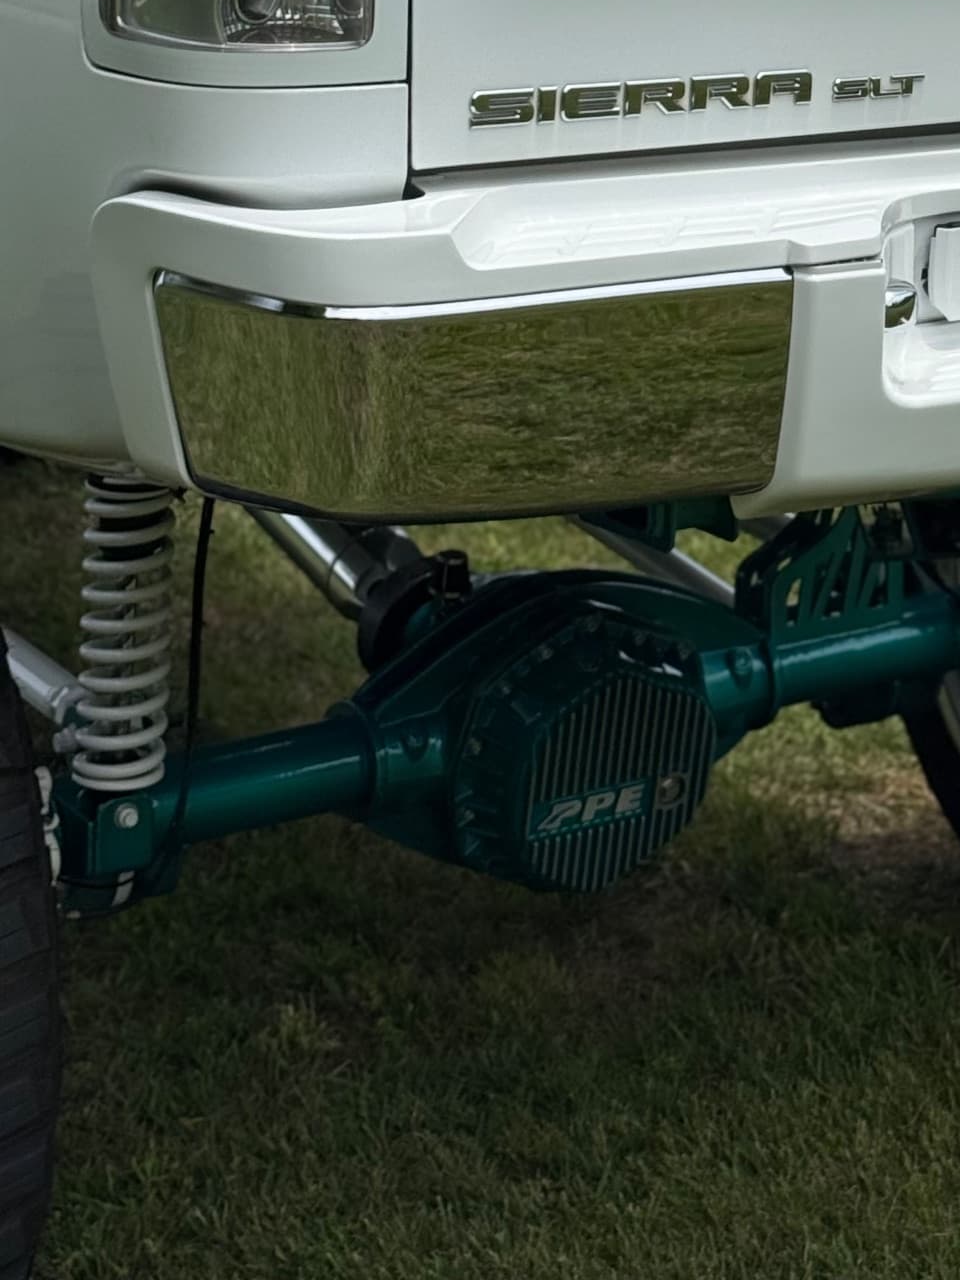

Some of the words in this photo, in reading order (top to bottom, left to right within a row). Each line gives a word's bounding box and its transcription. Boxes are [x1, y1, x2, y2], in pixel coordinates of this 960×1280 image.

[469, 69, 814, 128] SIERRA
[832, 72, 926, 102] SLT
[537, 784, 646, 830] PPE
